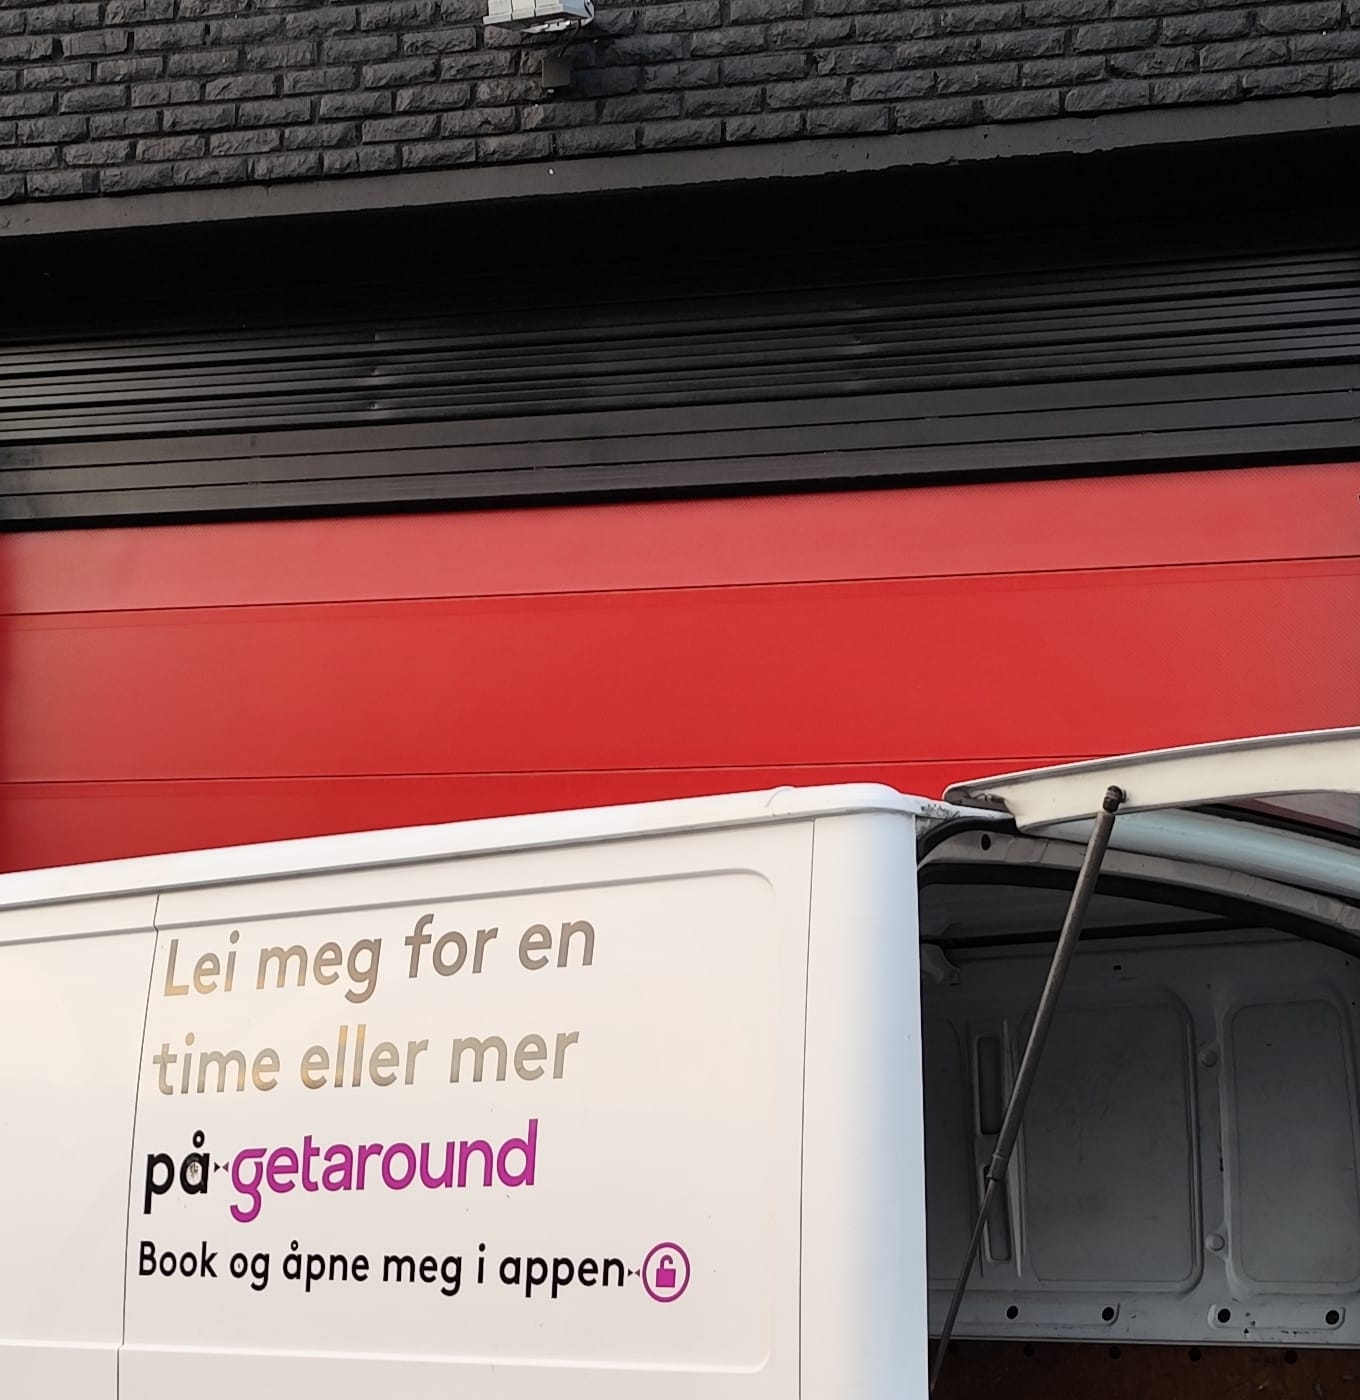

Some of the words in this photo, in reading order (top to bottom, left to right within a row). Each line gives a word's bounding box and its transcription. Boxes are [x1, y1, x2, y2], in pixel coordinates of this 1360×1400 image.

[163, 929, 240, 996] Lei
[256, 934, 382, 1003] meg
[404, 913, 498, 978] for
[518, 918, 595, 970] en
[152, 1031, 280, 1096] time
[300, 1023, 429, 1089] eller
[449, 1030, 579, 1084] mer
[142, 1129, 209, 1215] på
[229, 1118, 539, 1223] getaround
[138, 1240, 218, 1278] Book
[230, 1251, 271, 1292] og
[282, 1239, 369, 1293] åpne
[382, 1252, 463, 1297] meg
[476, 1243, 487, 1284] i
[498, 1255, 626, 1299] appen
